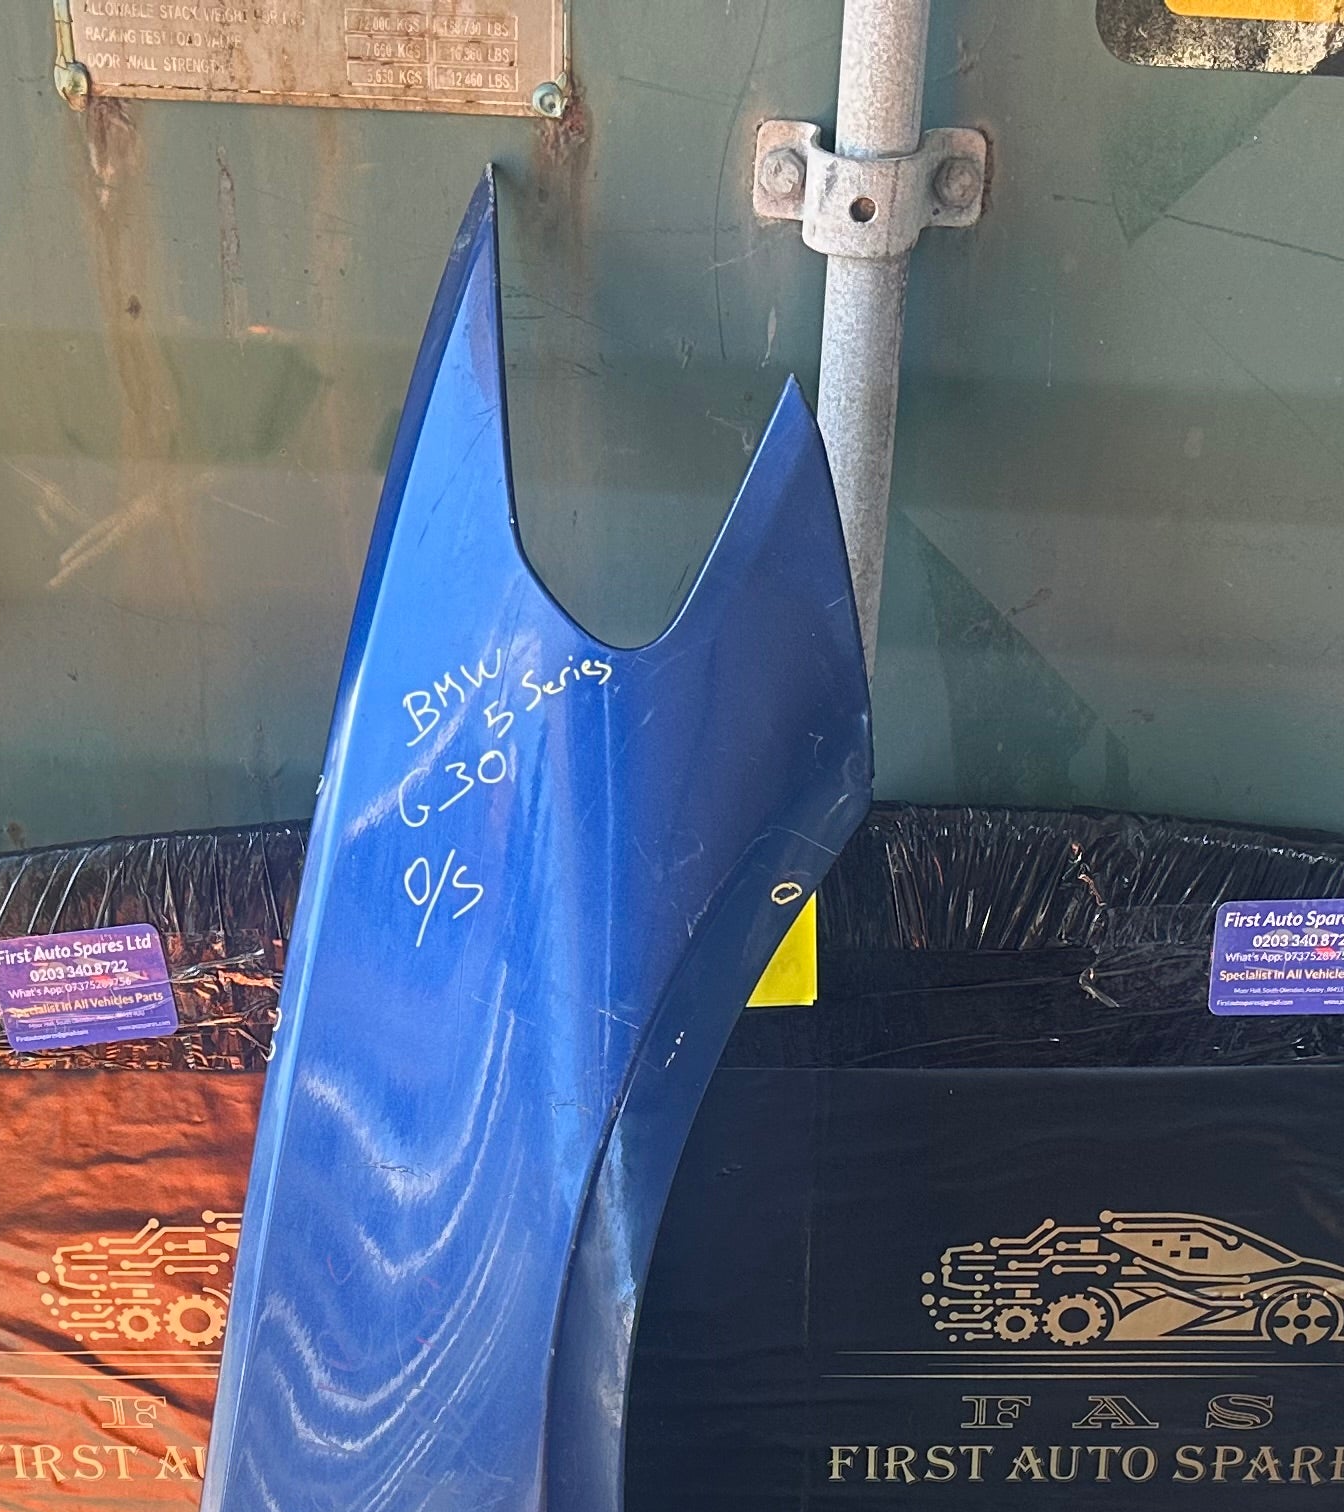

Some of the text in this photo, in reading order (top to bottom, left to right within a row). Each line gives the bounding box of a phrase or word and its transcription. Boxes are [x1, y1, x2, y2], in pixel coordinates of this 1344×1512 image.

[159, 5, 200, 22] STACK
[85, 28, 135, 44] RACKING
[488, 22, 509, 36] LBS
[397, 41, 420, 58] KGS
[488, 47, 509, 63] LBS
[87, 53, 121, 69] DOOR
[127, 54, 157, 71] WALL
[400, 69, 422, 85] KGS
[488, 72, 509, 88] LBS
[403, 647, 613, 747] BMW 5 Series
[398, 750, 507, 828] G30
[1224, 912, 1261, 928] First
[1262, 911, 1303, 927] Auto
[34, 944, 70, 961] Auto
[74, 939, 124, 958] Spares
[126, 933, 152, 950] Ltd
[1253, 934, 1289, 948] 0203
[1291, 934, 1318, 947] 340
[1225, 952, 1259, 962] What's
[1261, 952, 1283, 963] App:
[30, 959, 129, 982] 0203 340 8722
[1219, 969, 1272, 983] Specialist
[1286, 969, 1302, 980] All
[8, 986, 43, 999] What's
[74, 997, 89, 1009] All
[90, 993, 134, 1008] Vehicles
[136, 991, 164, 1004] Parts
[827, 1445, 994, 1485] FIRST
[1008, 1444, 1158, 1483] AUTO
